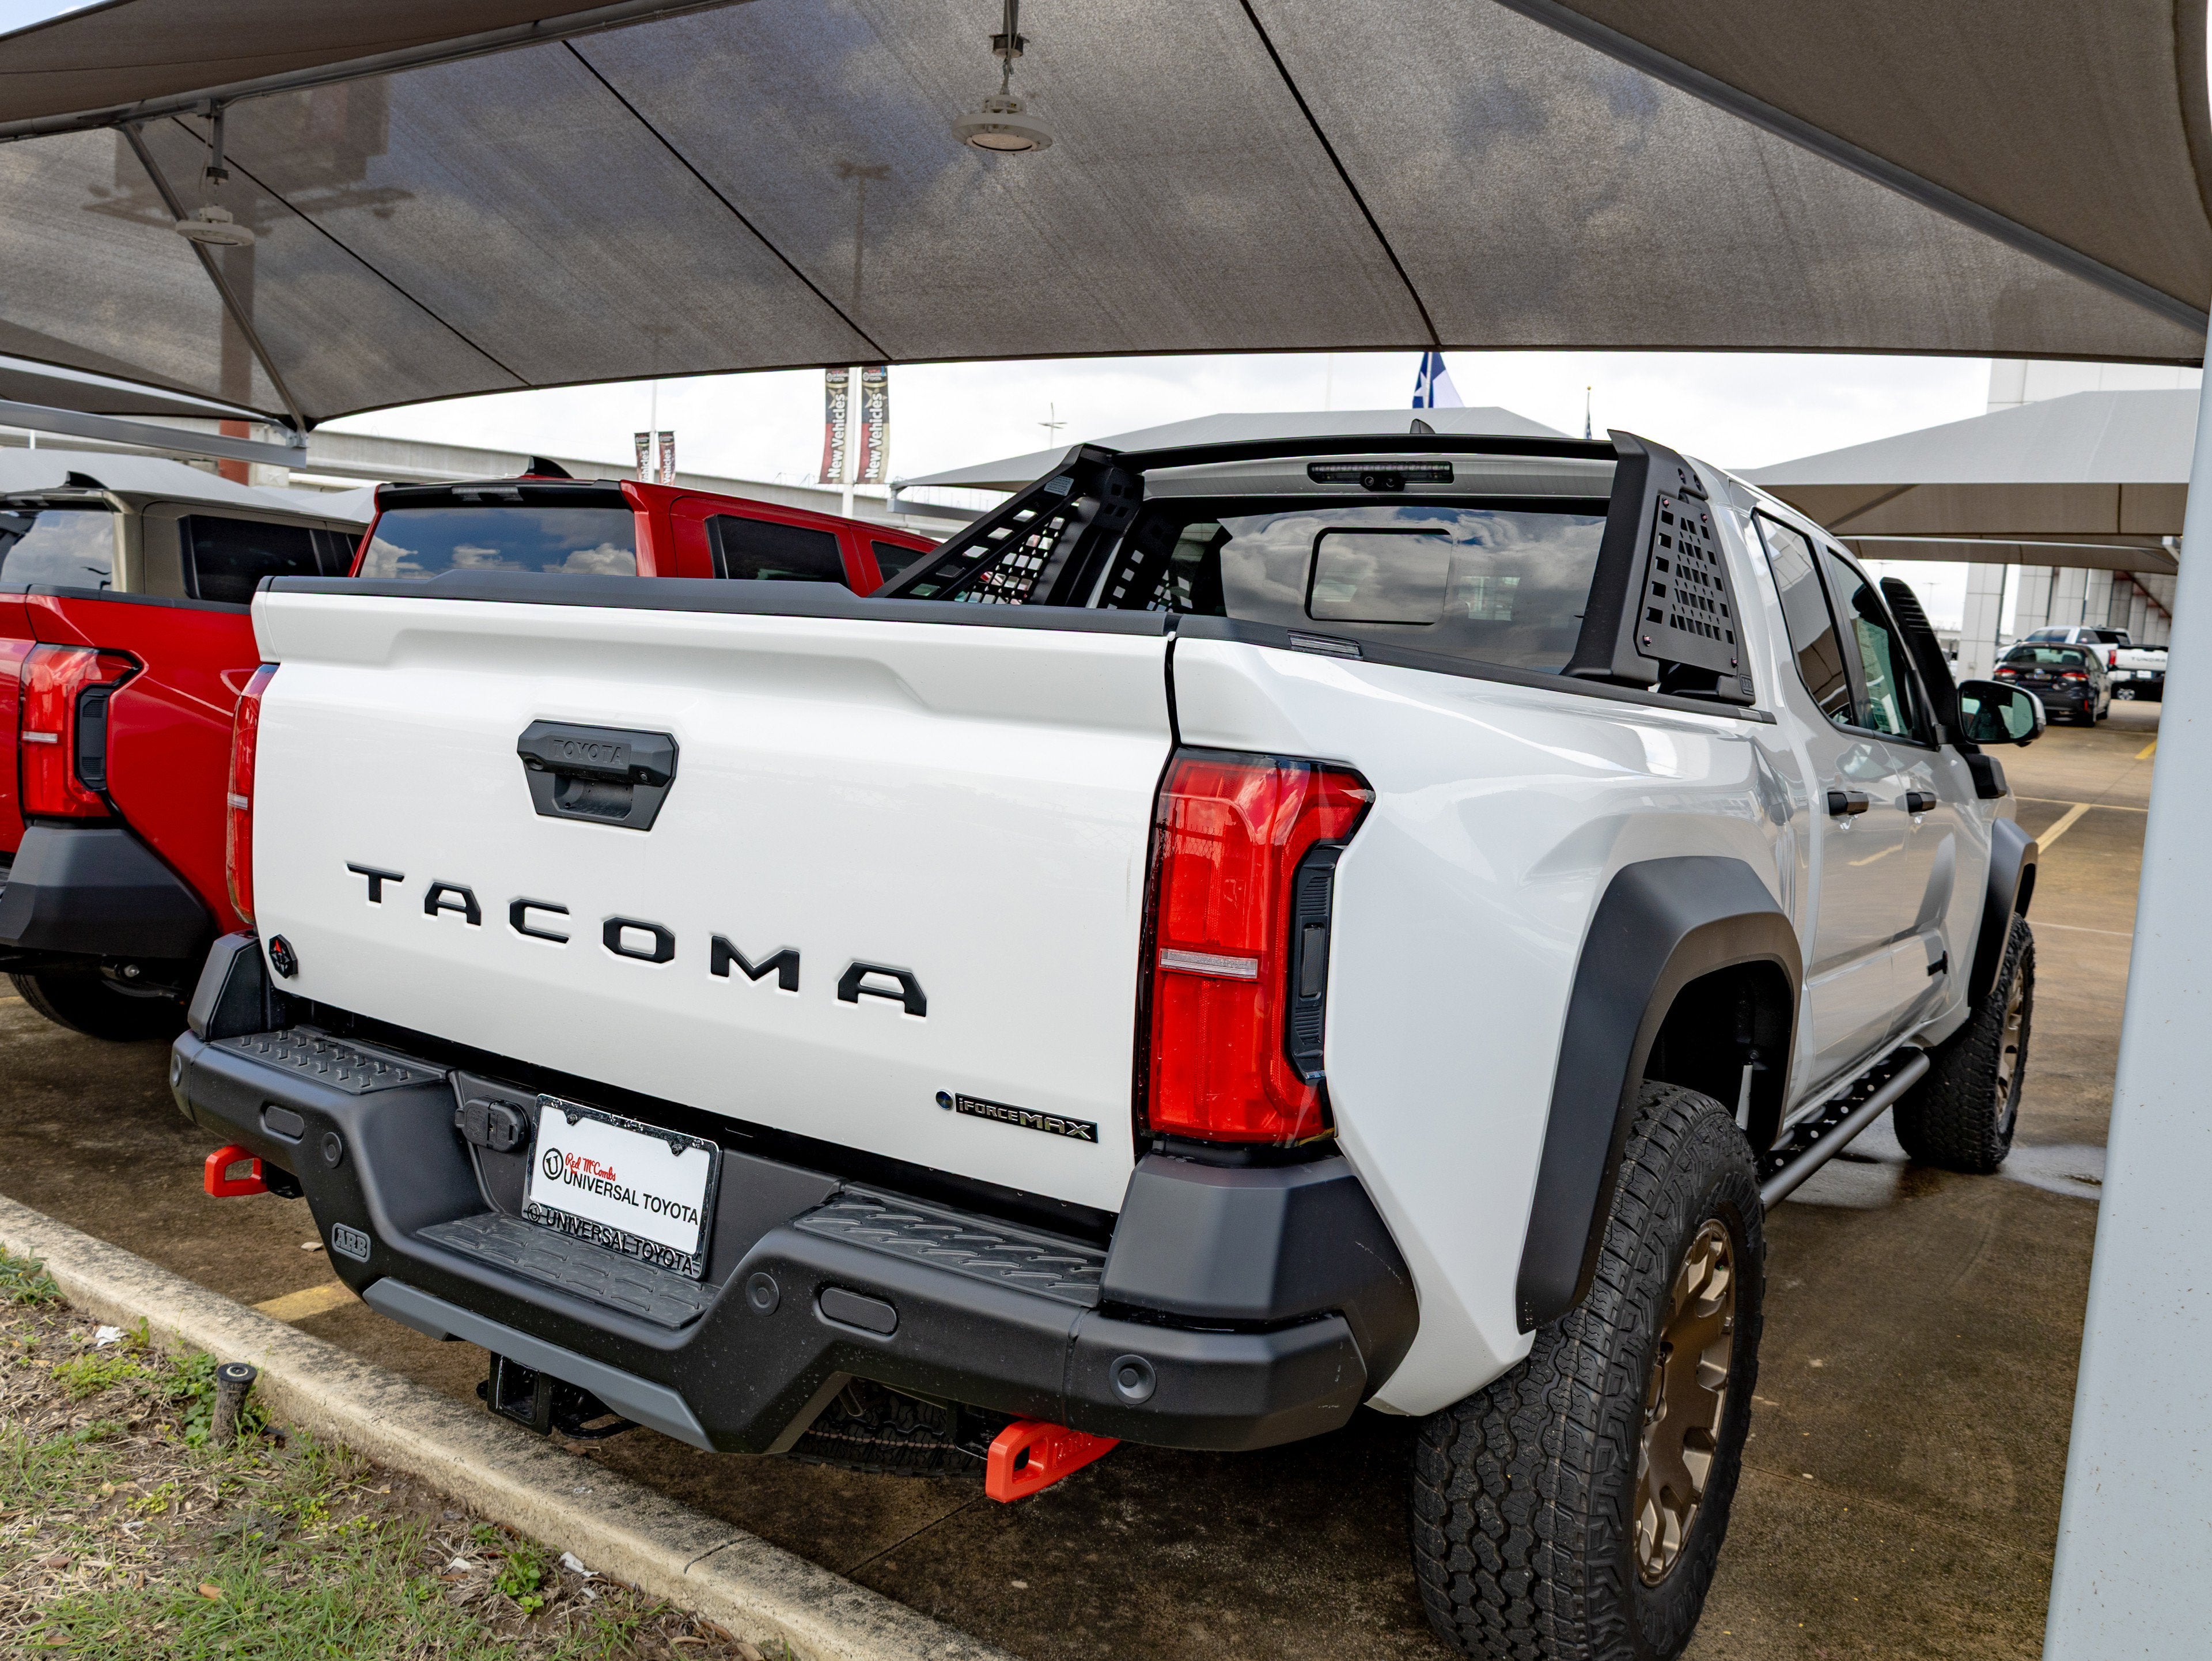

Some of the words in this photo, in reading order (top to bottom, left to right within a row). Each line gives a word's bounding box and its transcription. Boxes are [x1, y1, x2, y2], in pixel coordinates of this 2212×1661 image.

[832, 394, 845, 447] Vehicles
[869, 393, 882, 448] Vehicles
[828, 449, 843, 478] New
[865, 449, 881, 478] New
[554, 739, 623, 766] TOYOTA
[346, 862, 927, 1018] TACOMA
[565, 1152, 580, 1174] Red
[583, 1157, 616, 1181] McCombs
[563, 1168, 639, 1207] UNIVERSAL
[643, 1193, 698, 1225] TOYOTA
[336, 1229, 367, 1257] ARB
[547, 1208, 631, 1253] UNIVERSAL
[634, 1239, 694, 1275] TOYOTA
